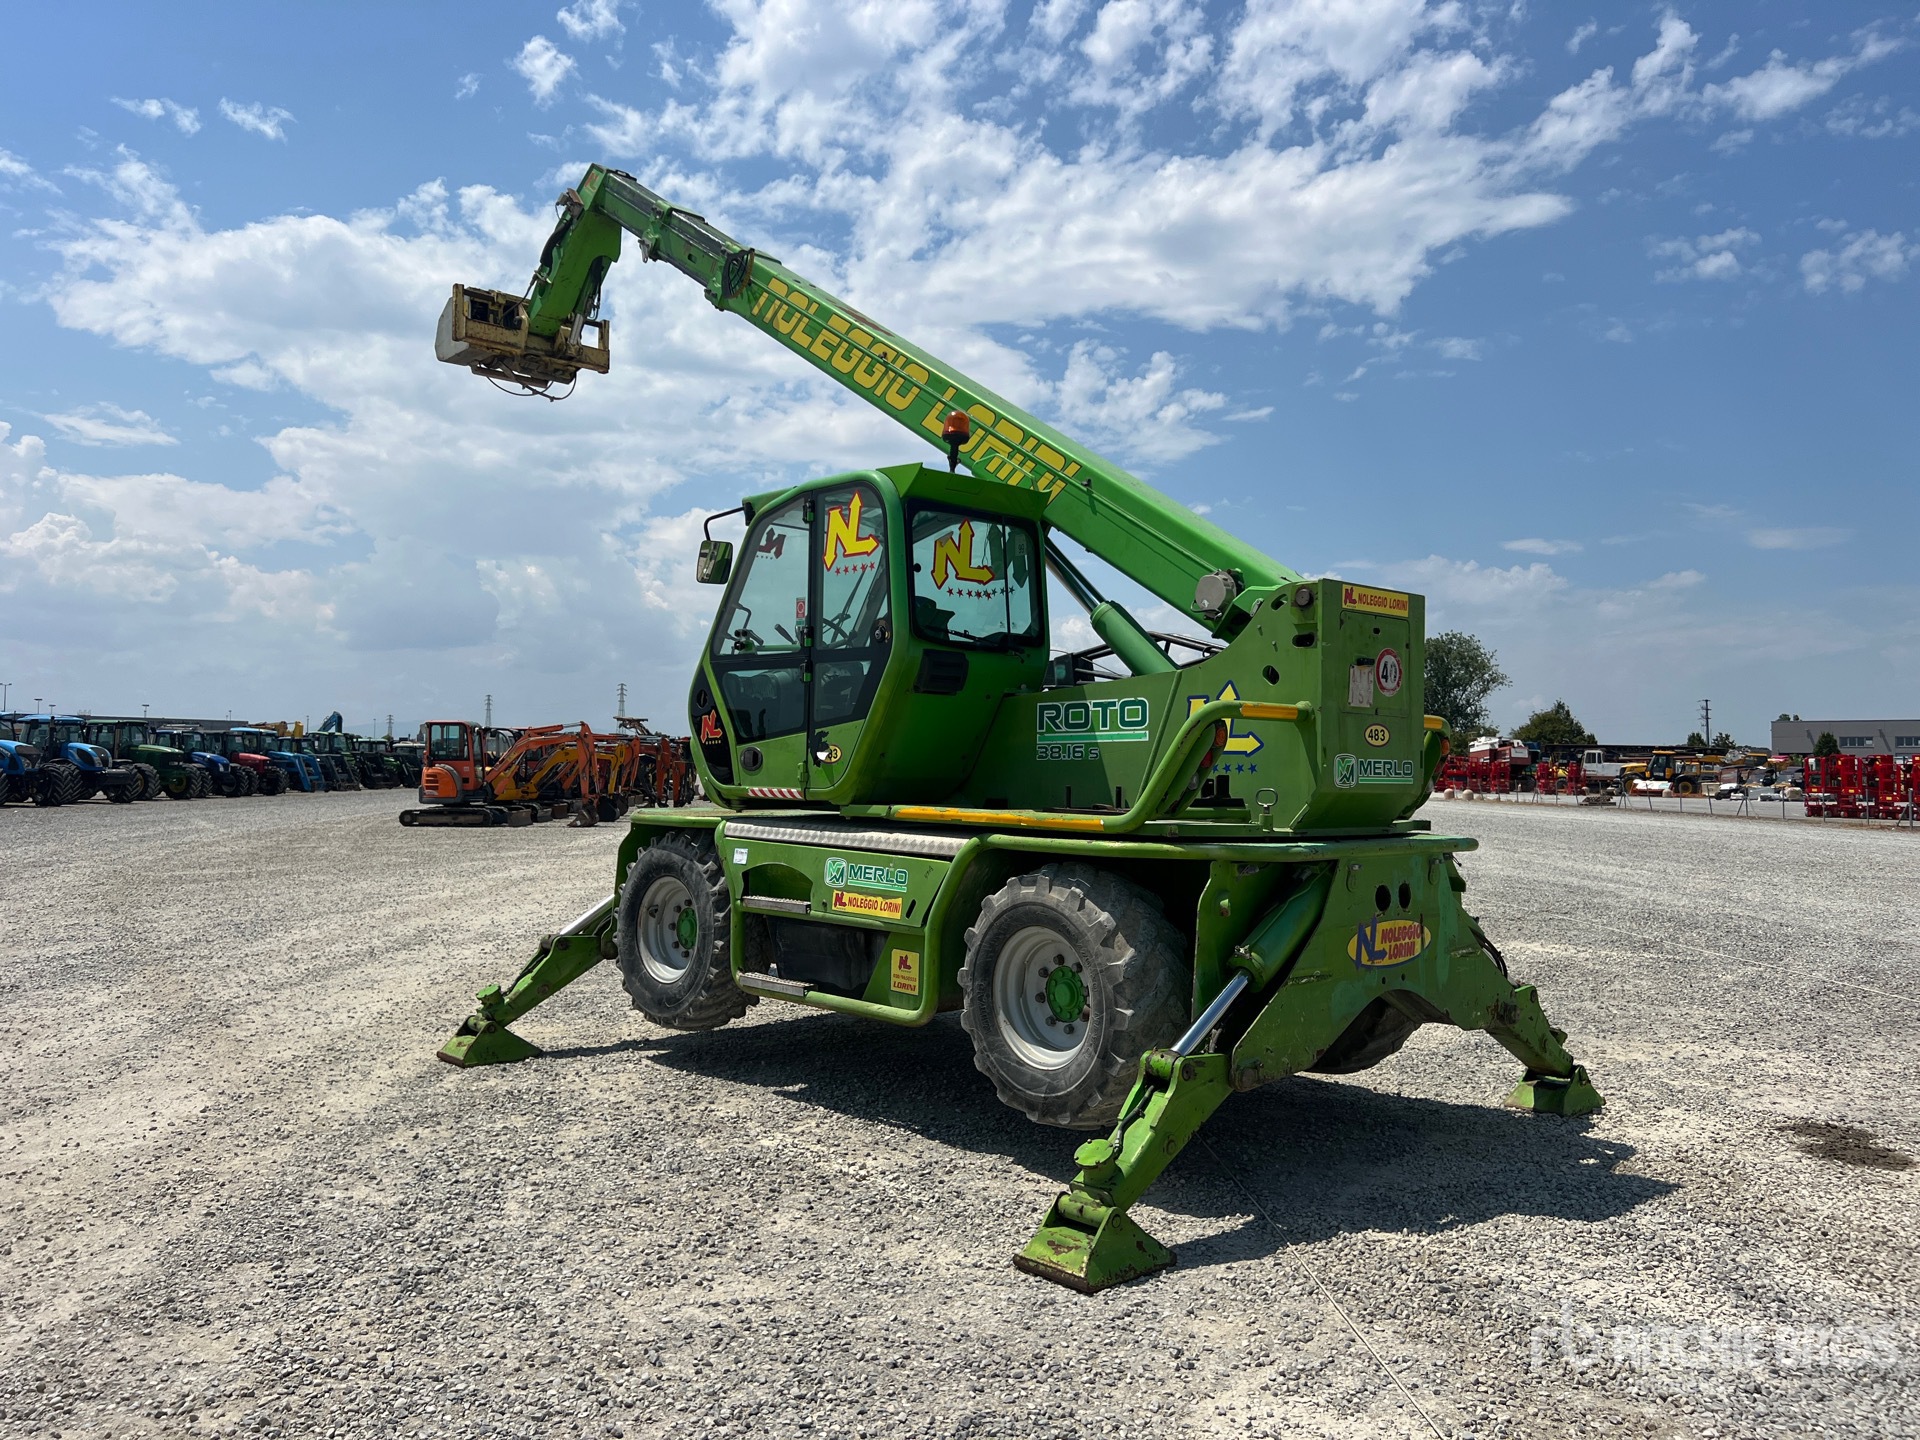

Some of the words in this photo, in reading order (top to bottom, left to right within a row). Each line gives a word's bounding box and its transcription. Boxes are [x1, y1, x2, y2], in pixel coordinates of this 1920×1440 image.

[752, 277, 930, 411] NOLEGGIO
[921, 387, 1083, 505] LORINI
[1358, 593, 1387, 608] NOLEGGIO
[1389, 598, 1408, 611] LORINI
[1037, 698, 1149, 732] ROTO
[1368, 729, 1386, 742] 483
[1036, 744, 1084, 761] 38.16
[1358, 758, 1413, 777] MERLO
[848, 863, 908, 885] MERLO
[848, 897, 878, 911] NOLEGGIO
[880, 901, 901, 913] LORINI
[1381, 924, 1421, 944] NOLEGGIO
[1388, 942, 1416, 960] LORINI
[893, 980, 916, 992] LORINI
